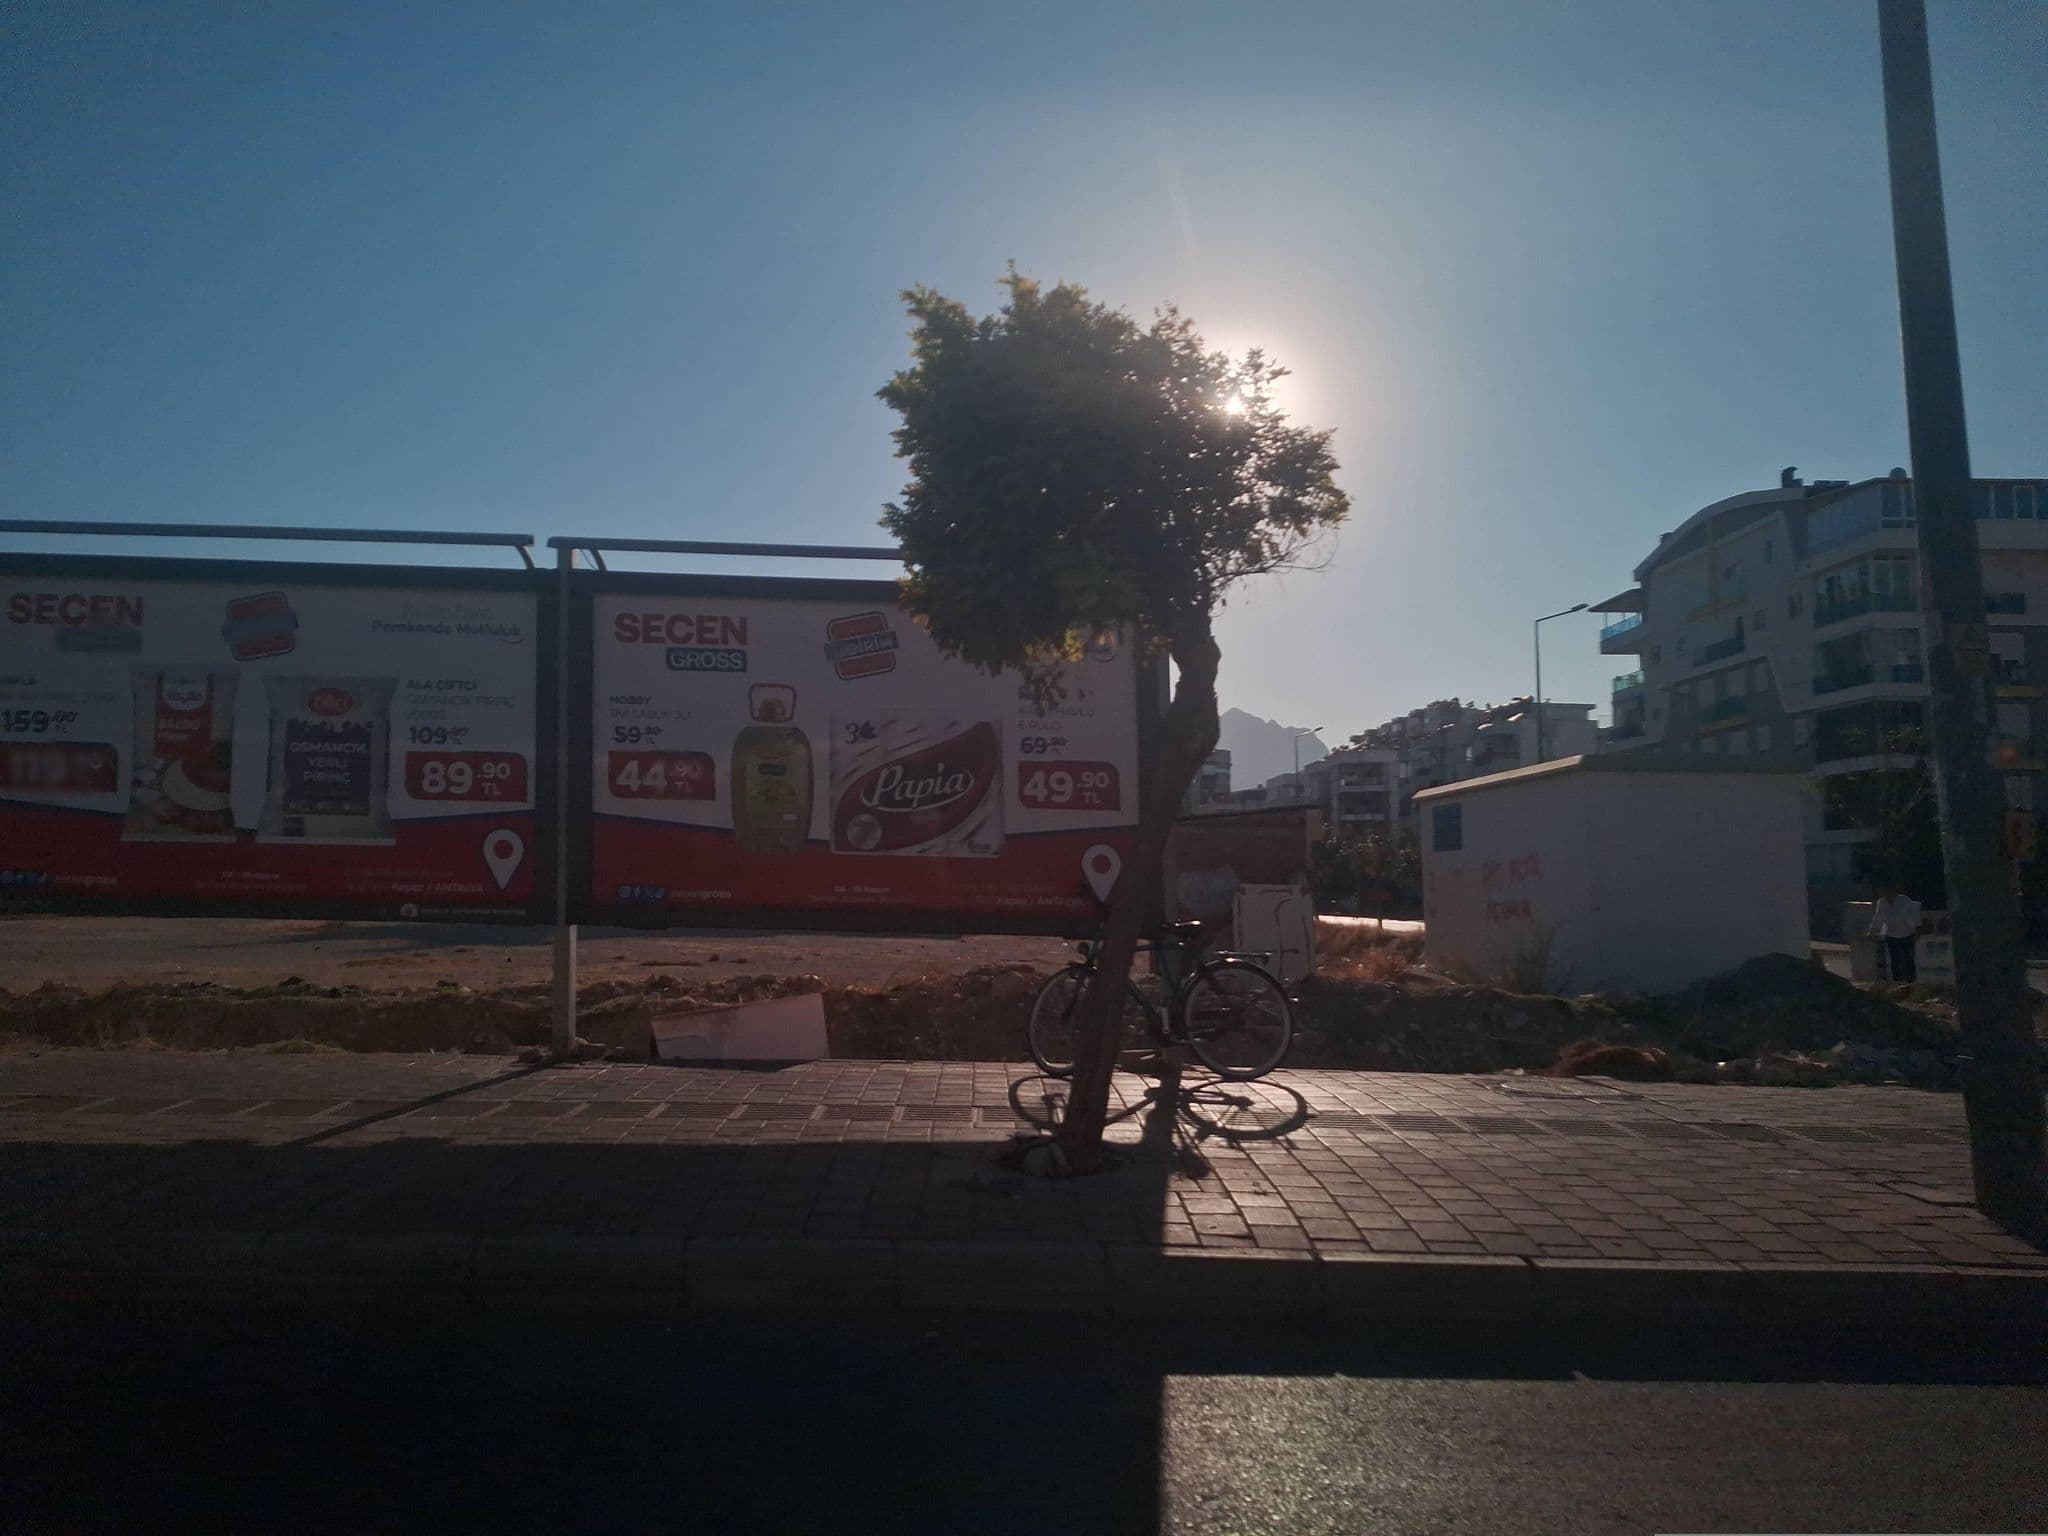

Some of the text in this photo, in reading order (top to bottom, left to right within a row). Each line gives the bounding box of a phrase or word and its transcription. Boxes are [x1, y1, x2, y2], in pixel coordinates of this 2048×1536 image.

[8, 593, 145, 626] SECEN
[615, 612, 748, 646] SECEN
[671, 652, 743, 670] GROSS
[408, 726, 448, 744] 109
[614, 726, 641, 743] 59
[1020, 737, 1048, 754] 69
[481, 782, 502, 796] TL
[866, 762, 972, 808] Papia
[1083, 790, 1101, 804] TL
